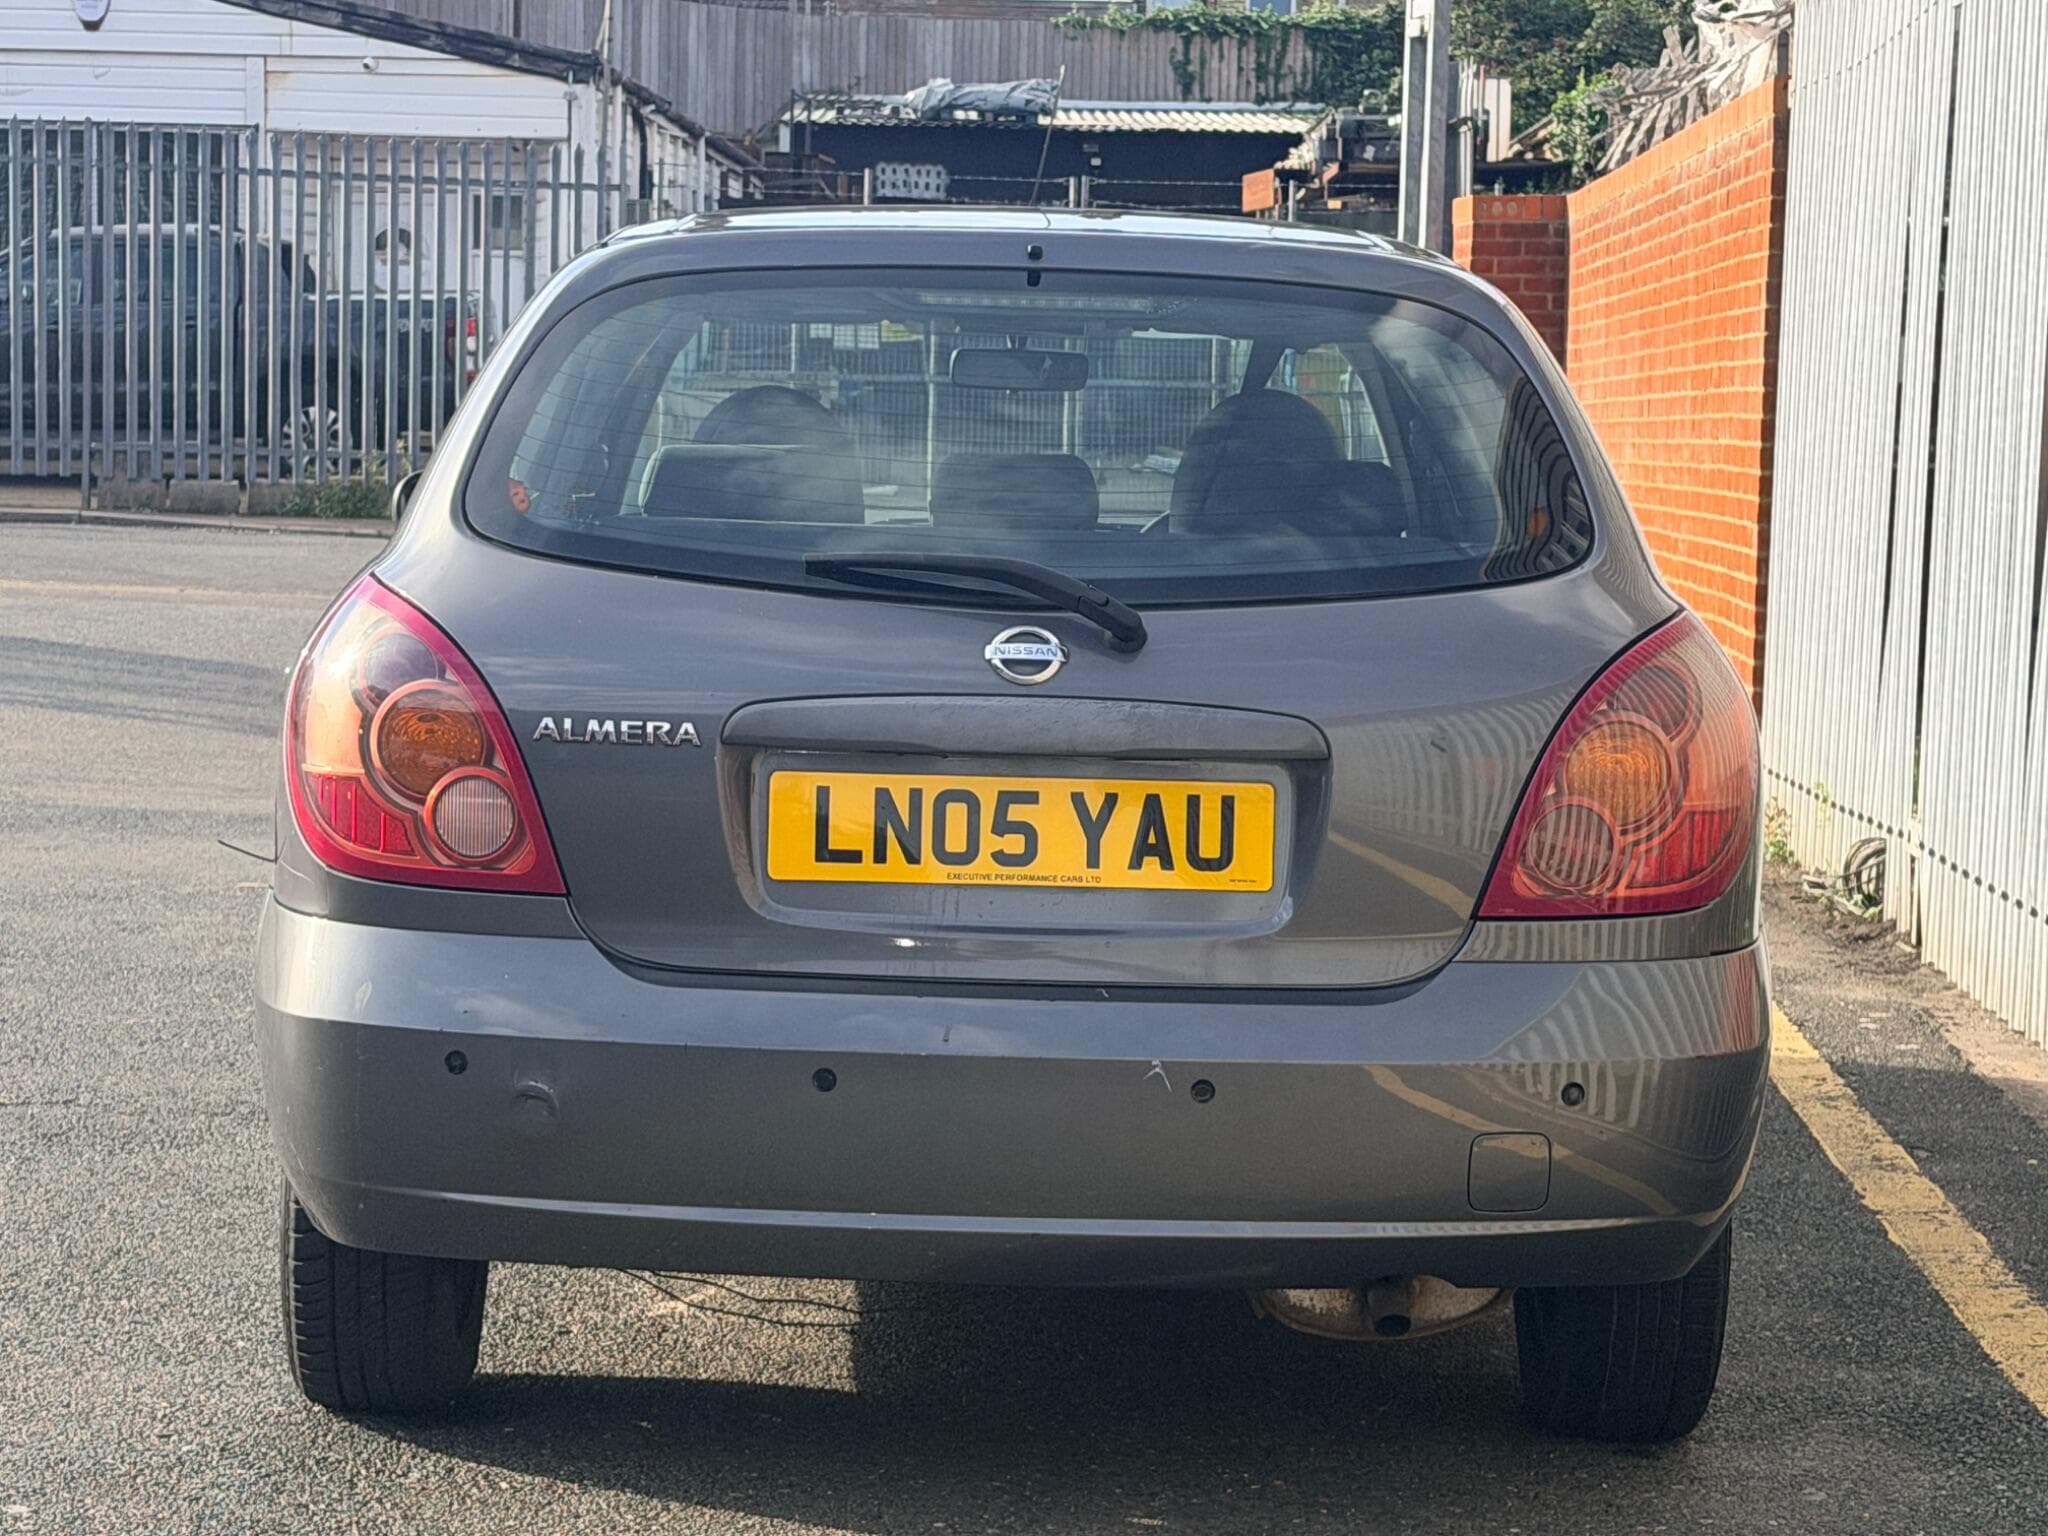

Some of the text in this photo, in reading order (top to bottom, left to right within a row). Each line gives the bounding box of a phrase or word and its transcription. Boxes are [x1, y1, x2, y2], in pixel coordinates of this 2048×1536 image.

[994, 646, 1058, 657] NISSAN
[532, 716, 702, 747] ALMERA
[814, 785, 1236, 873] LN05 YAU
[946, 872, 1101, 884] EXECUTIVE PERFORMANCE CARS LTD
